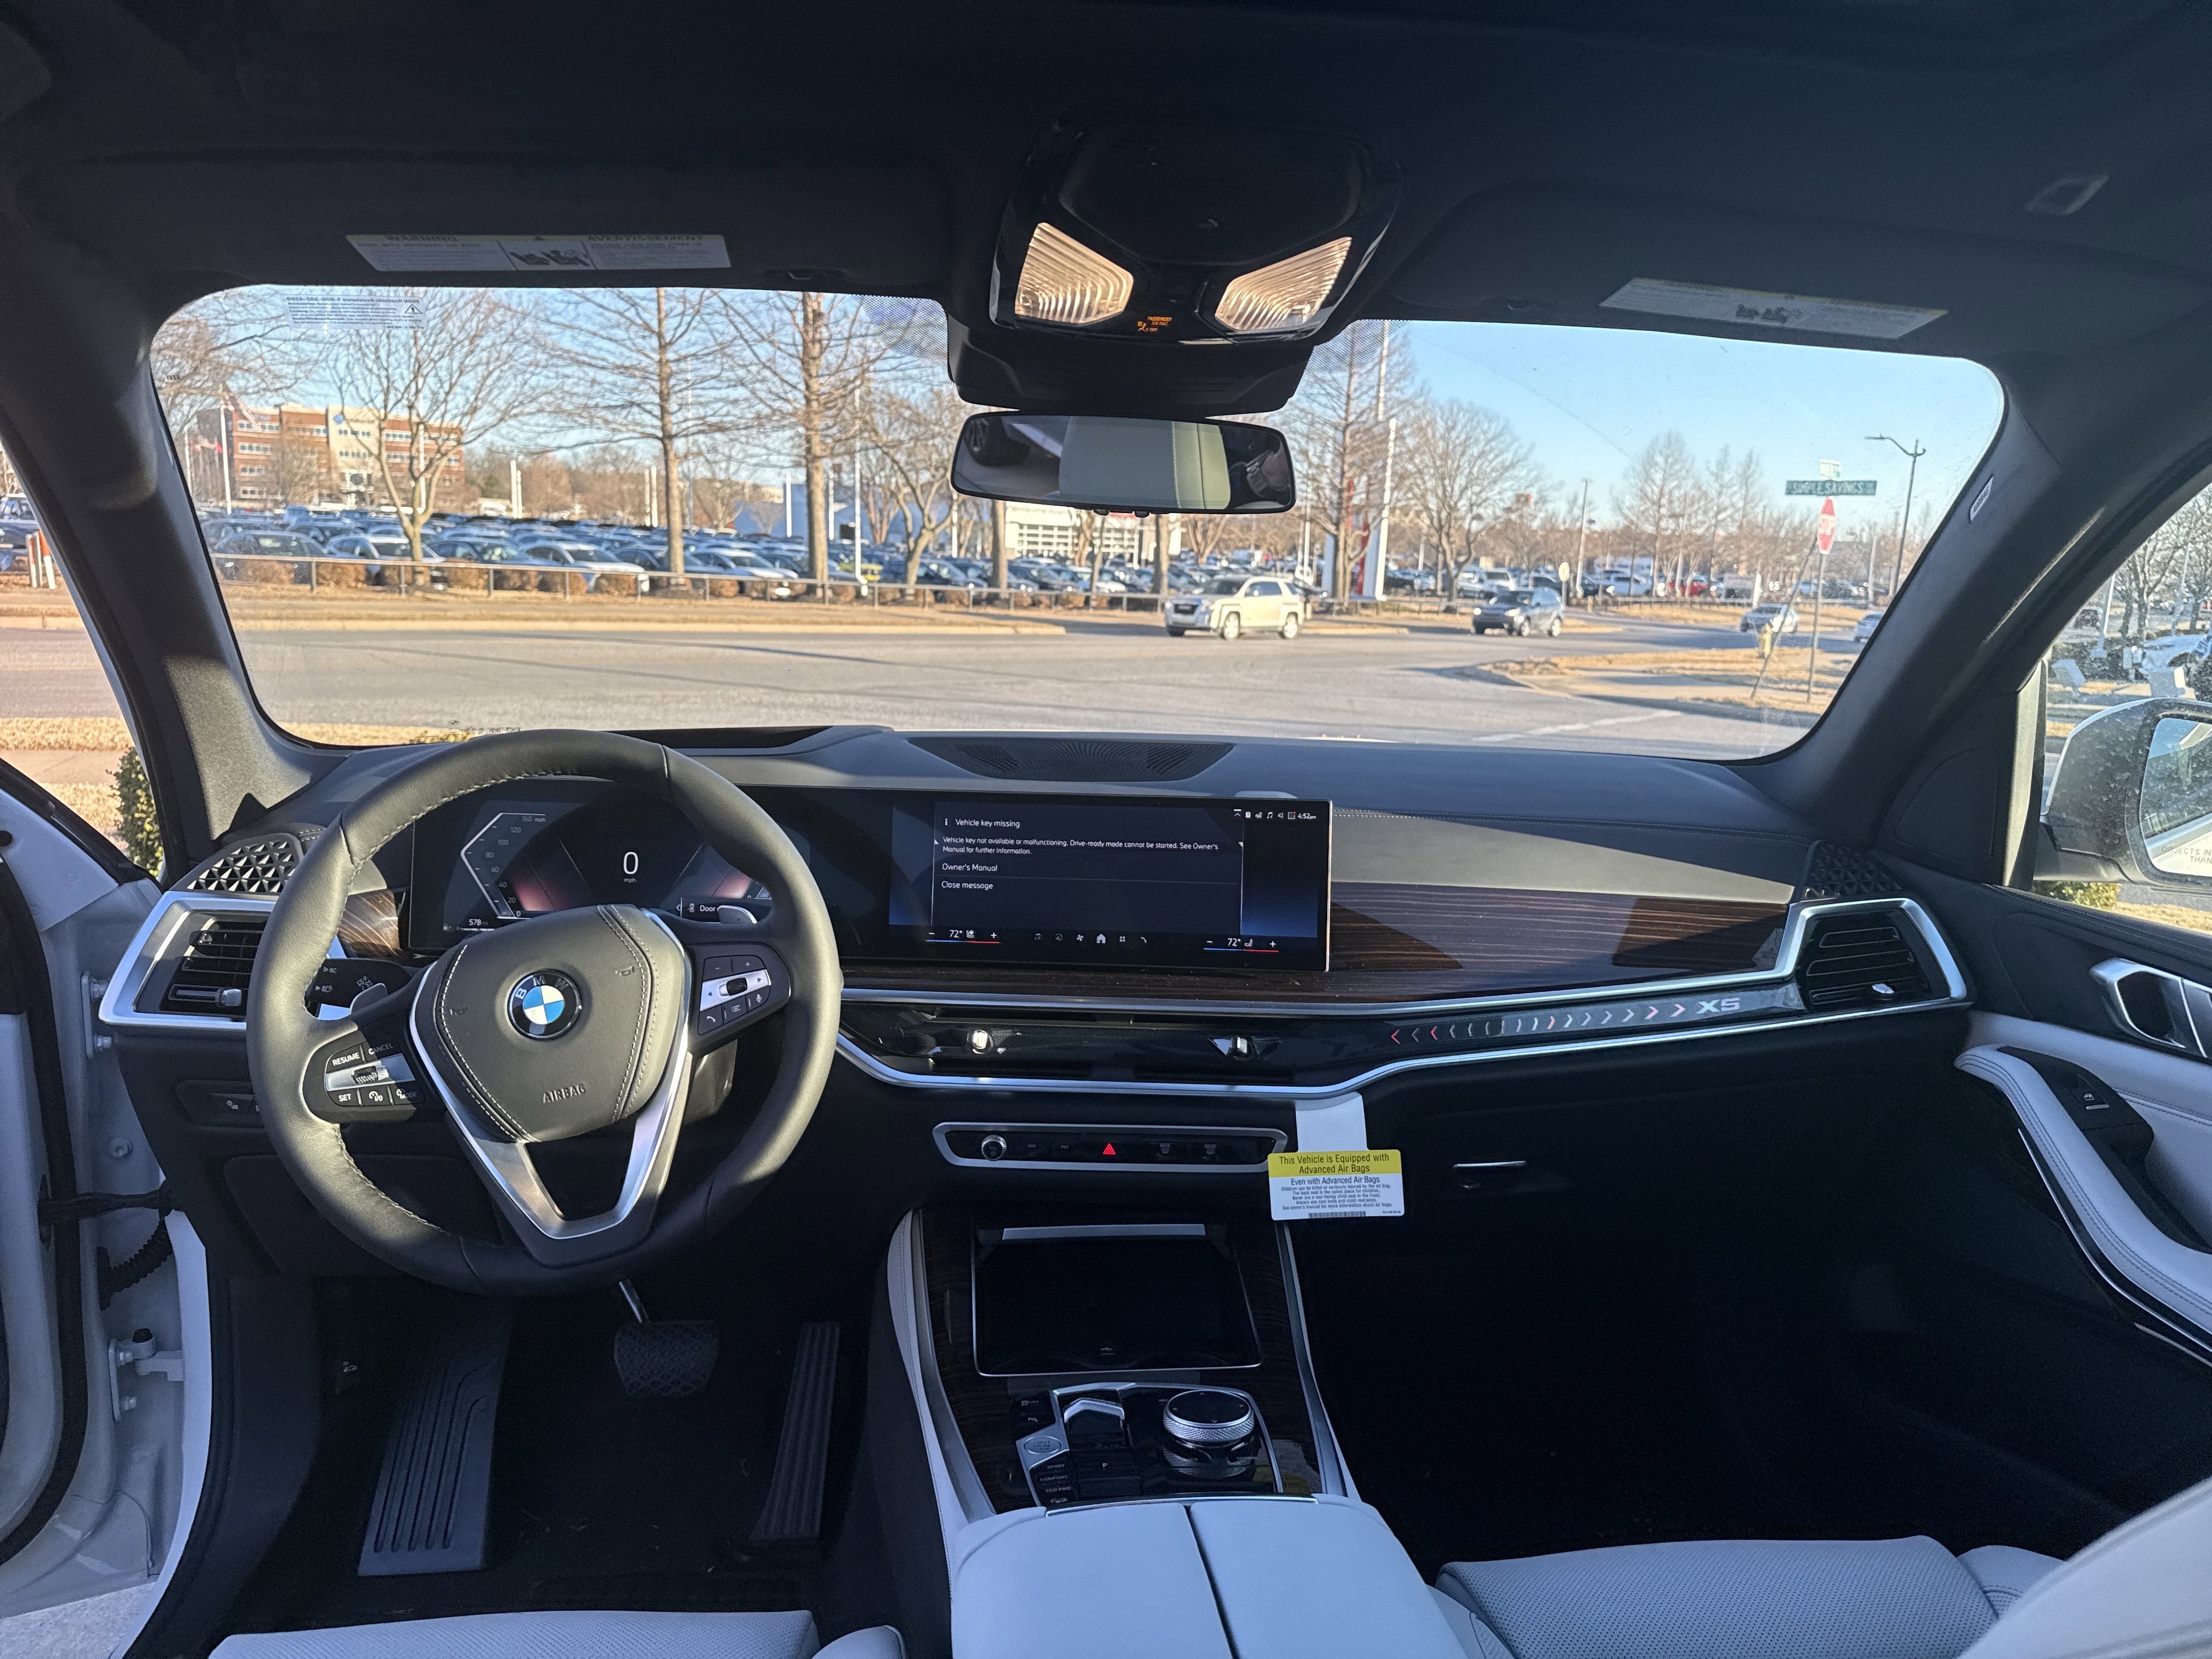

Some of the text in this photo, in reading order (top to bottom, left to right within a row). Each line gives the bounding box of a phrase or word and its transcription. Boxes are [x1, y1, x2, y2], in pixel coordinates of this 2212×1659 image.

[1818, 514, 1836, 536] STOP
[980, 819, 992, 827] key
[994, 820, 1020, 828] missing
[1023, 838, 1068, 847] malfunctioning.
[1070, 839, 1104, 848] Drive-ready
[2162, 846, 2200, 855] OBJECTS
[623, 851, 639, 874] 0
[2190, 856, 2212, 864] THAN
[962, 882, 994, 890] message
[515, 975, 569, 1000] BMW
[1695, 997, 1740, 1014] X5
[368, 1043, 393, 1055] CANCEL
[332, 1052, 360, 1066] RESUME
[338, 1093, 352, 1102] SET
[400, 1091, 417, 1099] MODE
[543, 1084, 586, 1104] AIRBAG
[1279, 1153, 1389, 1164] This Vehicle is Equipped with
[1299, 1164, 1370, 1174] Advanced Air Bags
